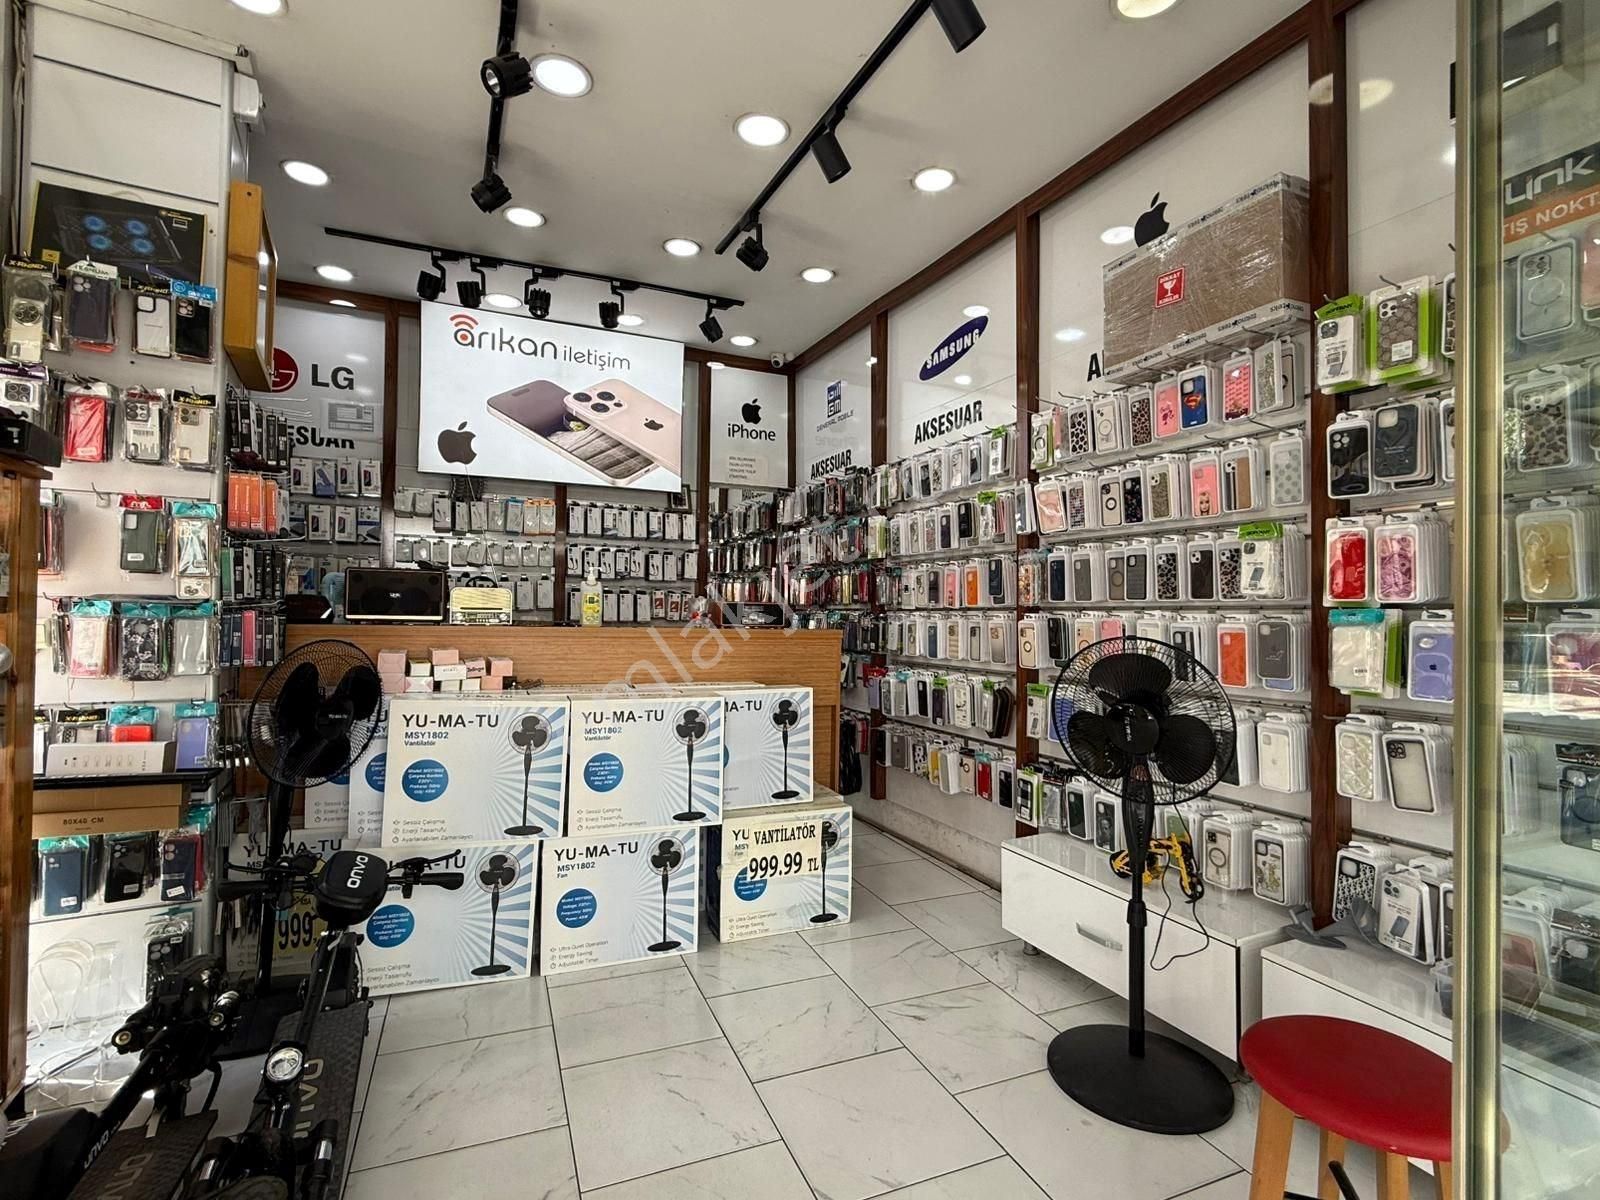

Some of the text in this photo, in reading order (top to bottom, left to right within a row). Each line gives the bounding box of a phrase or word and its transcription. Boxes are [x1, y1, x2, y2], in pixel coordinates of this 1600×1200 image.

[563, 345, 631, 371] iletişim
[926, 328, 980, 369] SAMSUNG
[311, 363, 355, 390] LG
[727, 423, 776, 441] iPhone
[914, 400, 983, 444] AKSESUAR
[811, 449, 852, 480] AKSESUAR
[402, 714, 499, 728] YU-MA-TU
[582, 709, 665, 724] YU-MA-TU
[404, 731, 449, 739] MSY1802
[584, 727, 622, 735] MSY1802
[91, 816, 105, 824] CM
[753, 822, 816, 845] VANTİLATÖR
[554, 841, 639, 861] YU-MA-TU
[557, 861, 596, 872] MSY1802
[749, 851, 820, 880] 999.99 TL
